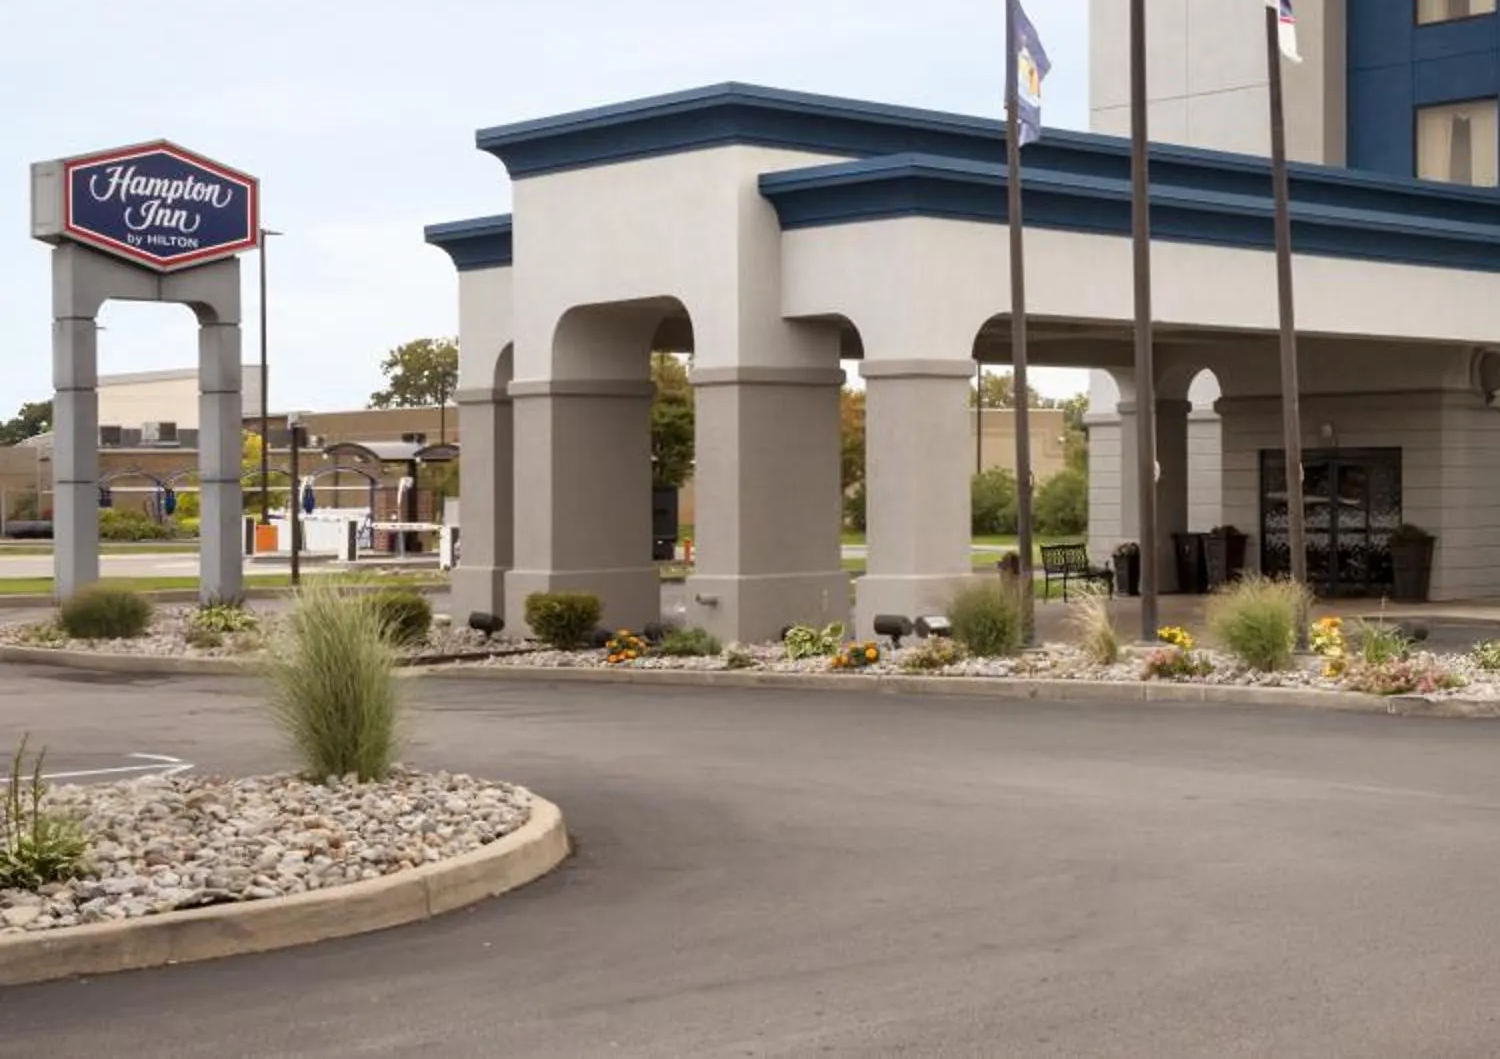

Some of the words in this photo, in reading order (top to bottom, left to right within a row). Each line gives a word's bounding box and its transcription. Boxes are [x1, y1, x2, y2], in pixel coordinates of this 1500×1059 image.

[89, 165, 232, 208] Hampton
[124, 200, 200, 233] Inn
[127, 233, 141, 246] by
[147, 235, 199, 248] HILTON
